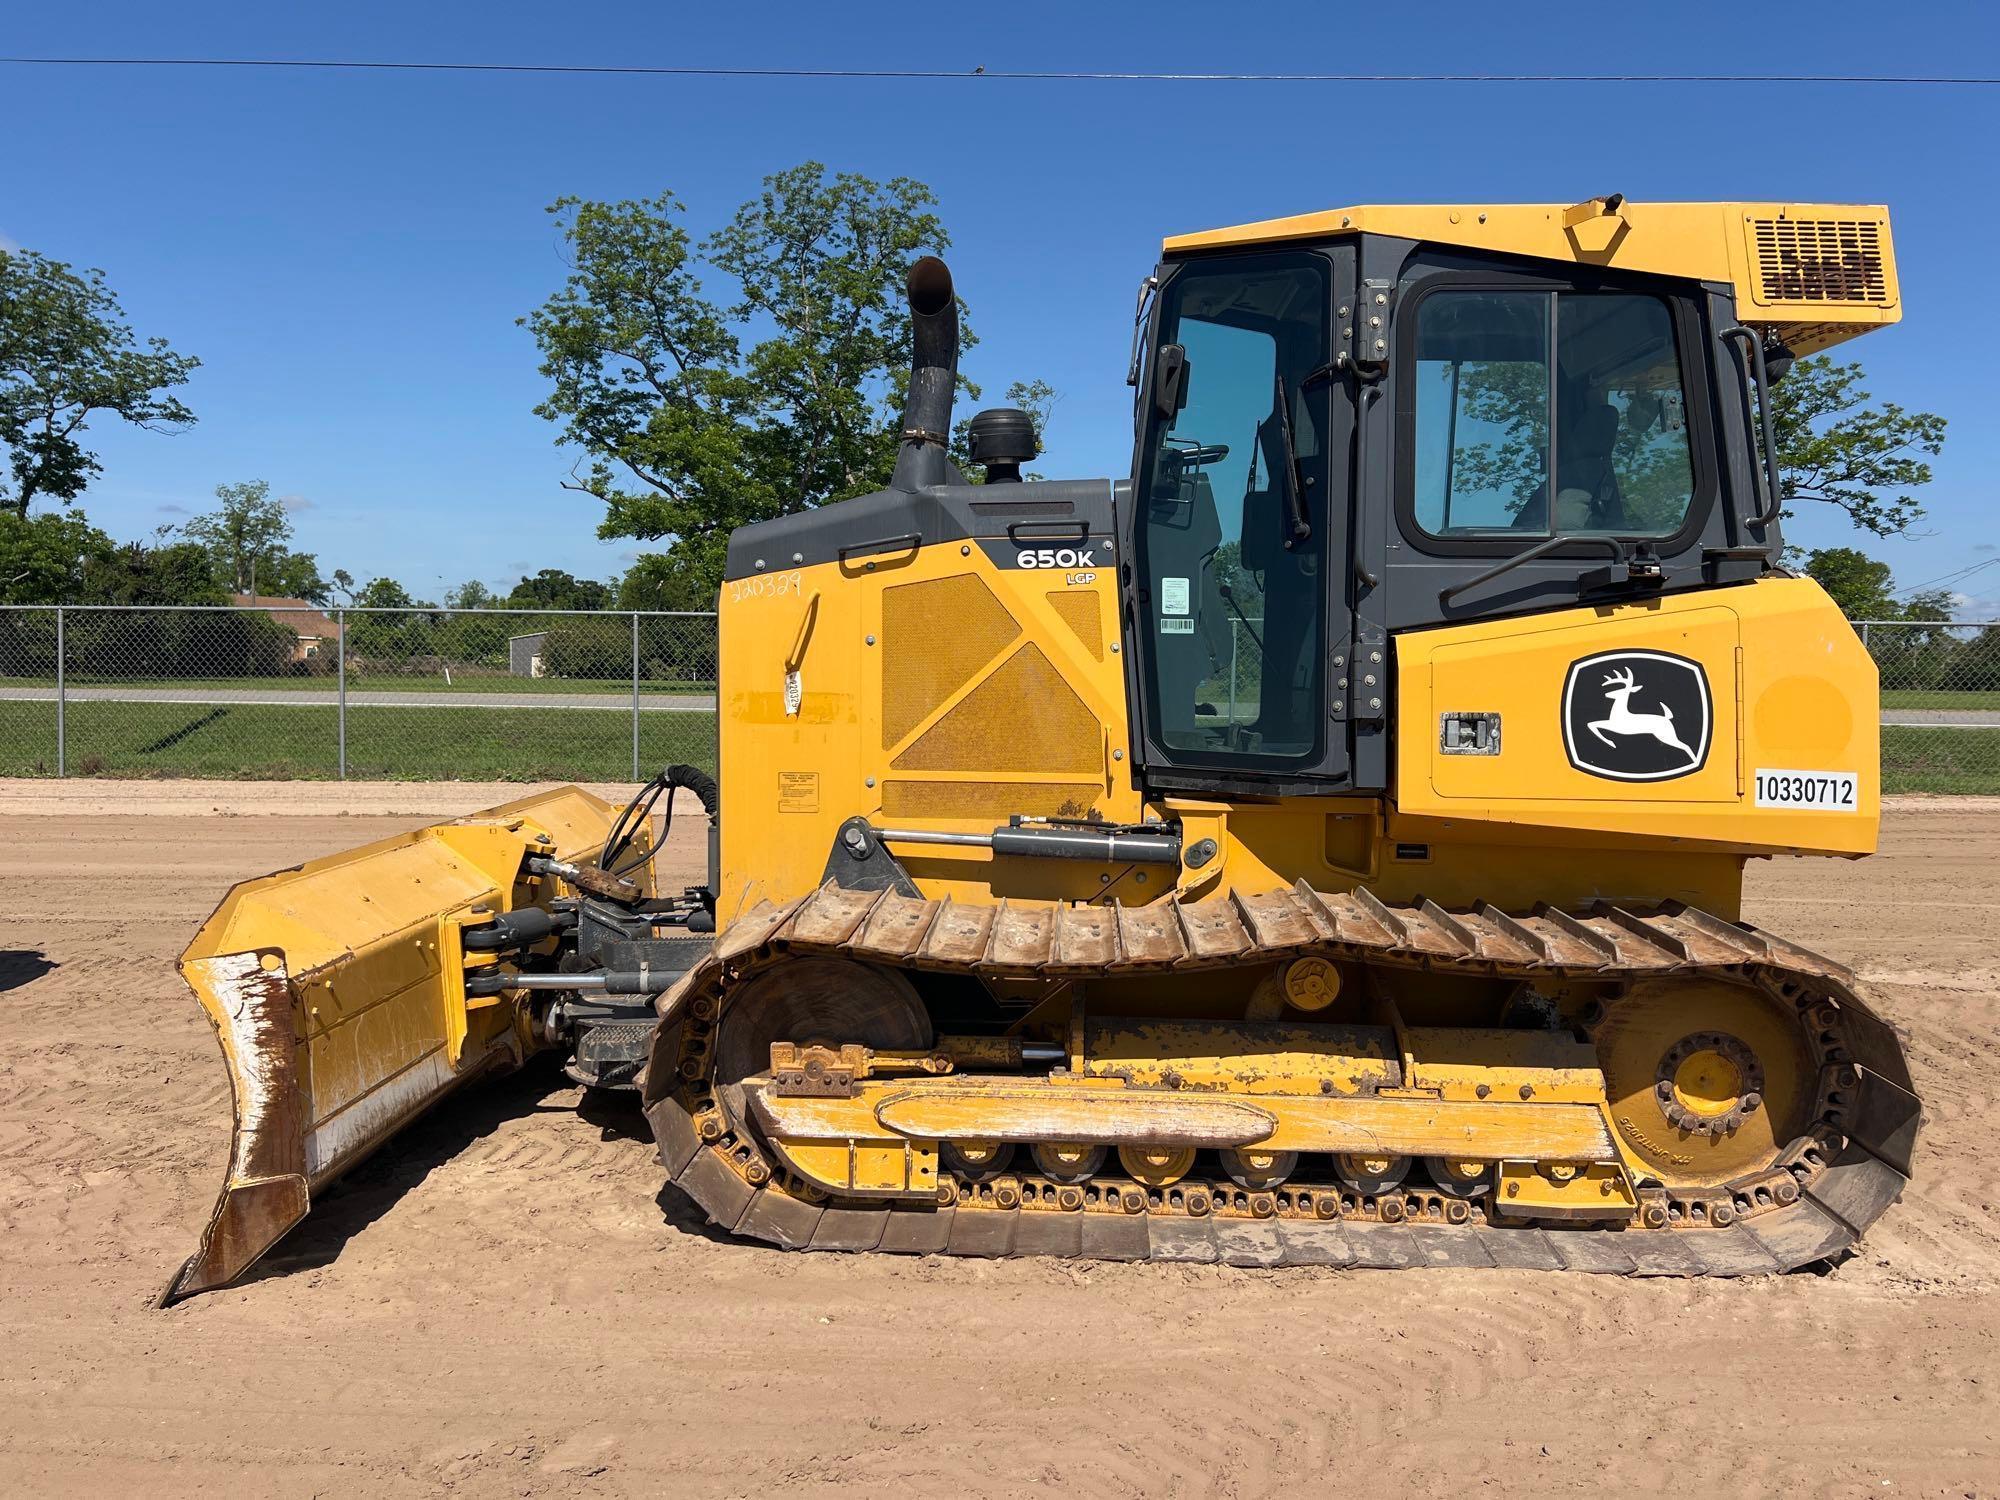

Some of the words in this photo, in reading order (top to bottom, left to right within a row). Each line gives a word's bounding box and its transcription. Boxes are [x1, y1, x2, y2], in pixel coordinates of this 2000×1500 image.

[1017, 549, 1096, 569] 650K
[1066, 573, 1096, 585] LGP
[1756, 776, 1853, 804] 10330712
